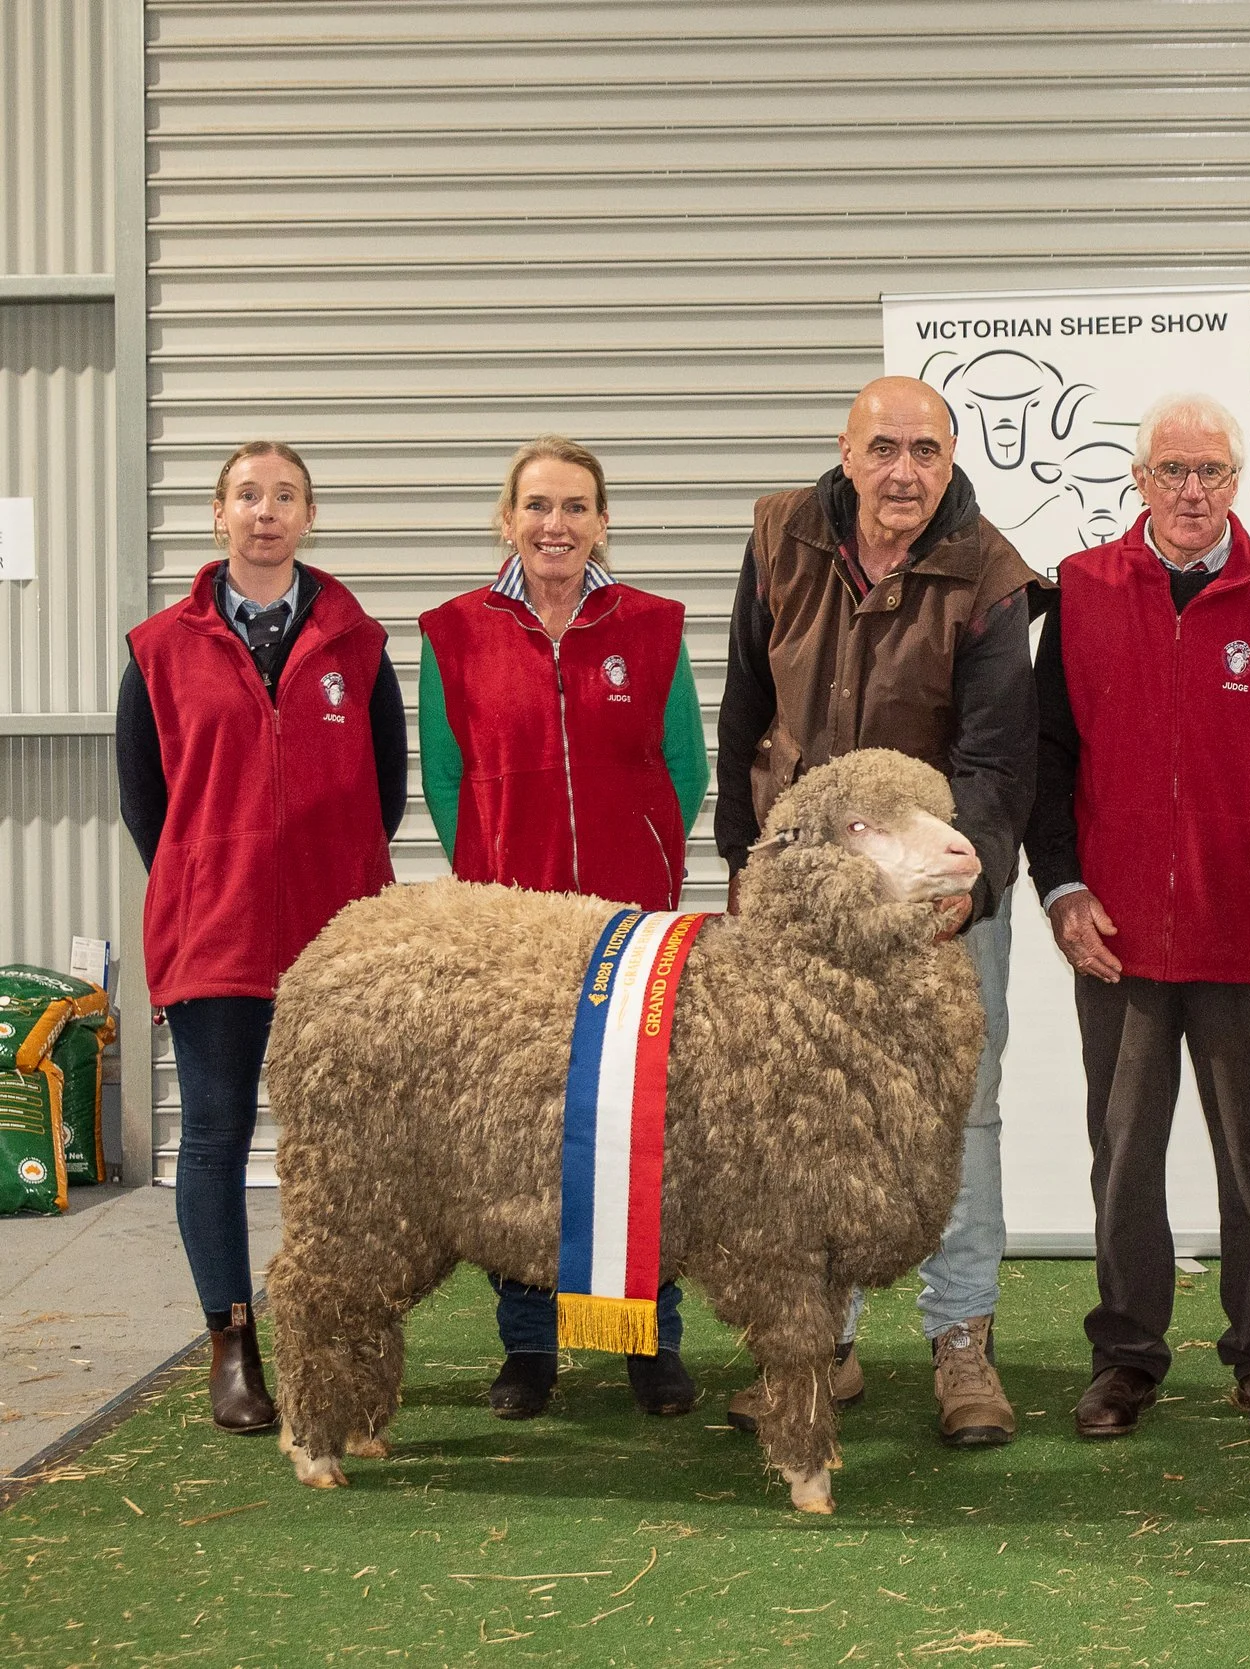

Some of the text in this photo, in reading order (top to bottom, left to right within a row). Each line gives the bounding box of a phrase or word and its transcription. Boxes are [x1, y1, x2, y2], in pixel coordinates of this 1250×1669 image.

[916, 312, 1228, 340] VICTORIAN SHEEP SHOW
[1222, 682, 1249, 692] JUDGE
[607, 694, 631, 703] JUDGE
[323, 713, 346, 724] JUDGE
[593, 912, 642, 992] 2026 VICTORIA
[645, 979, 667, 1037] GRAND
[657, 920, 694, 976] CHAMPION
